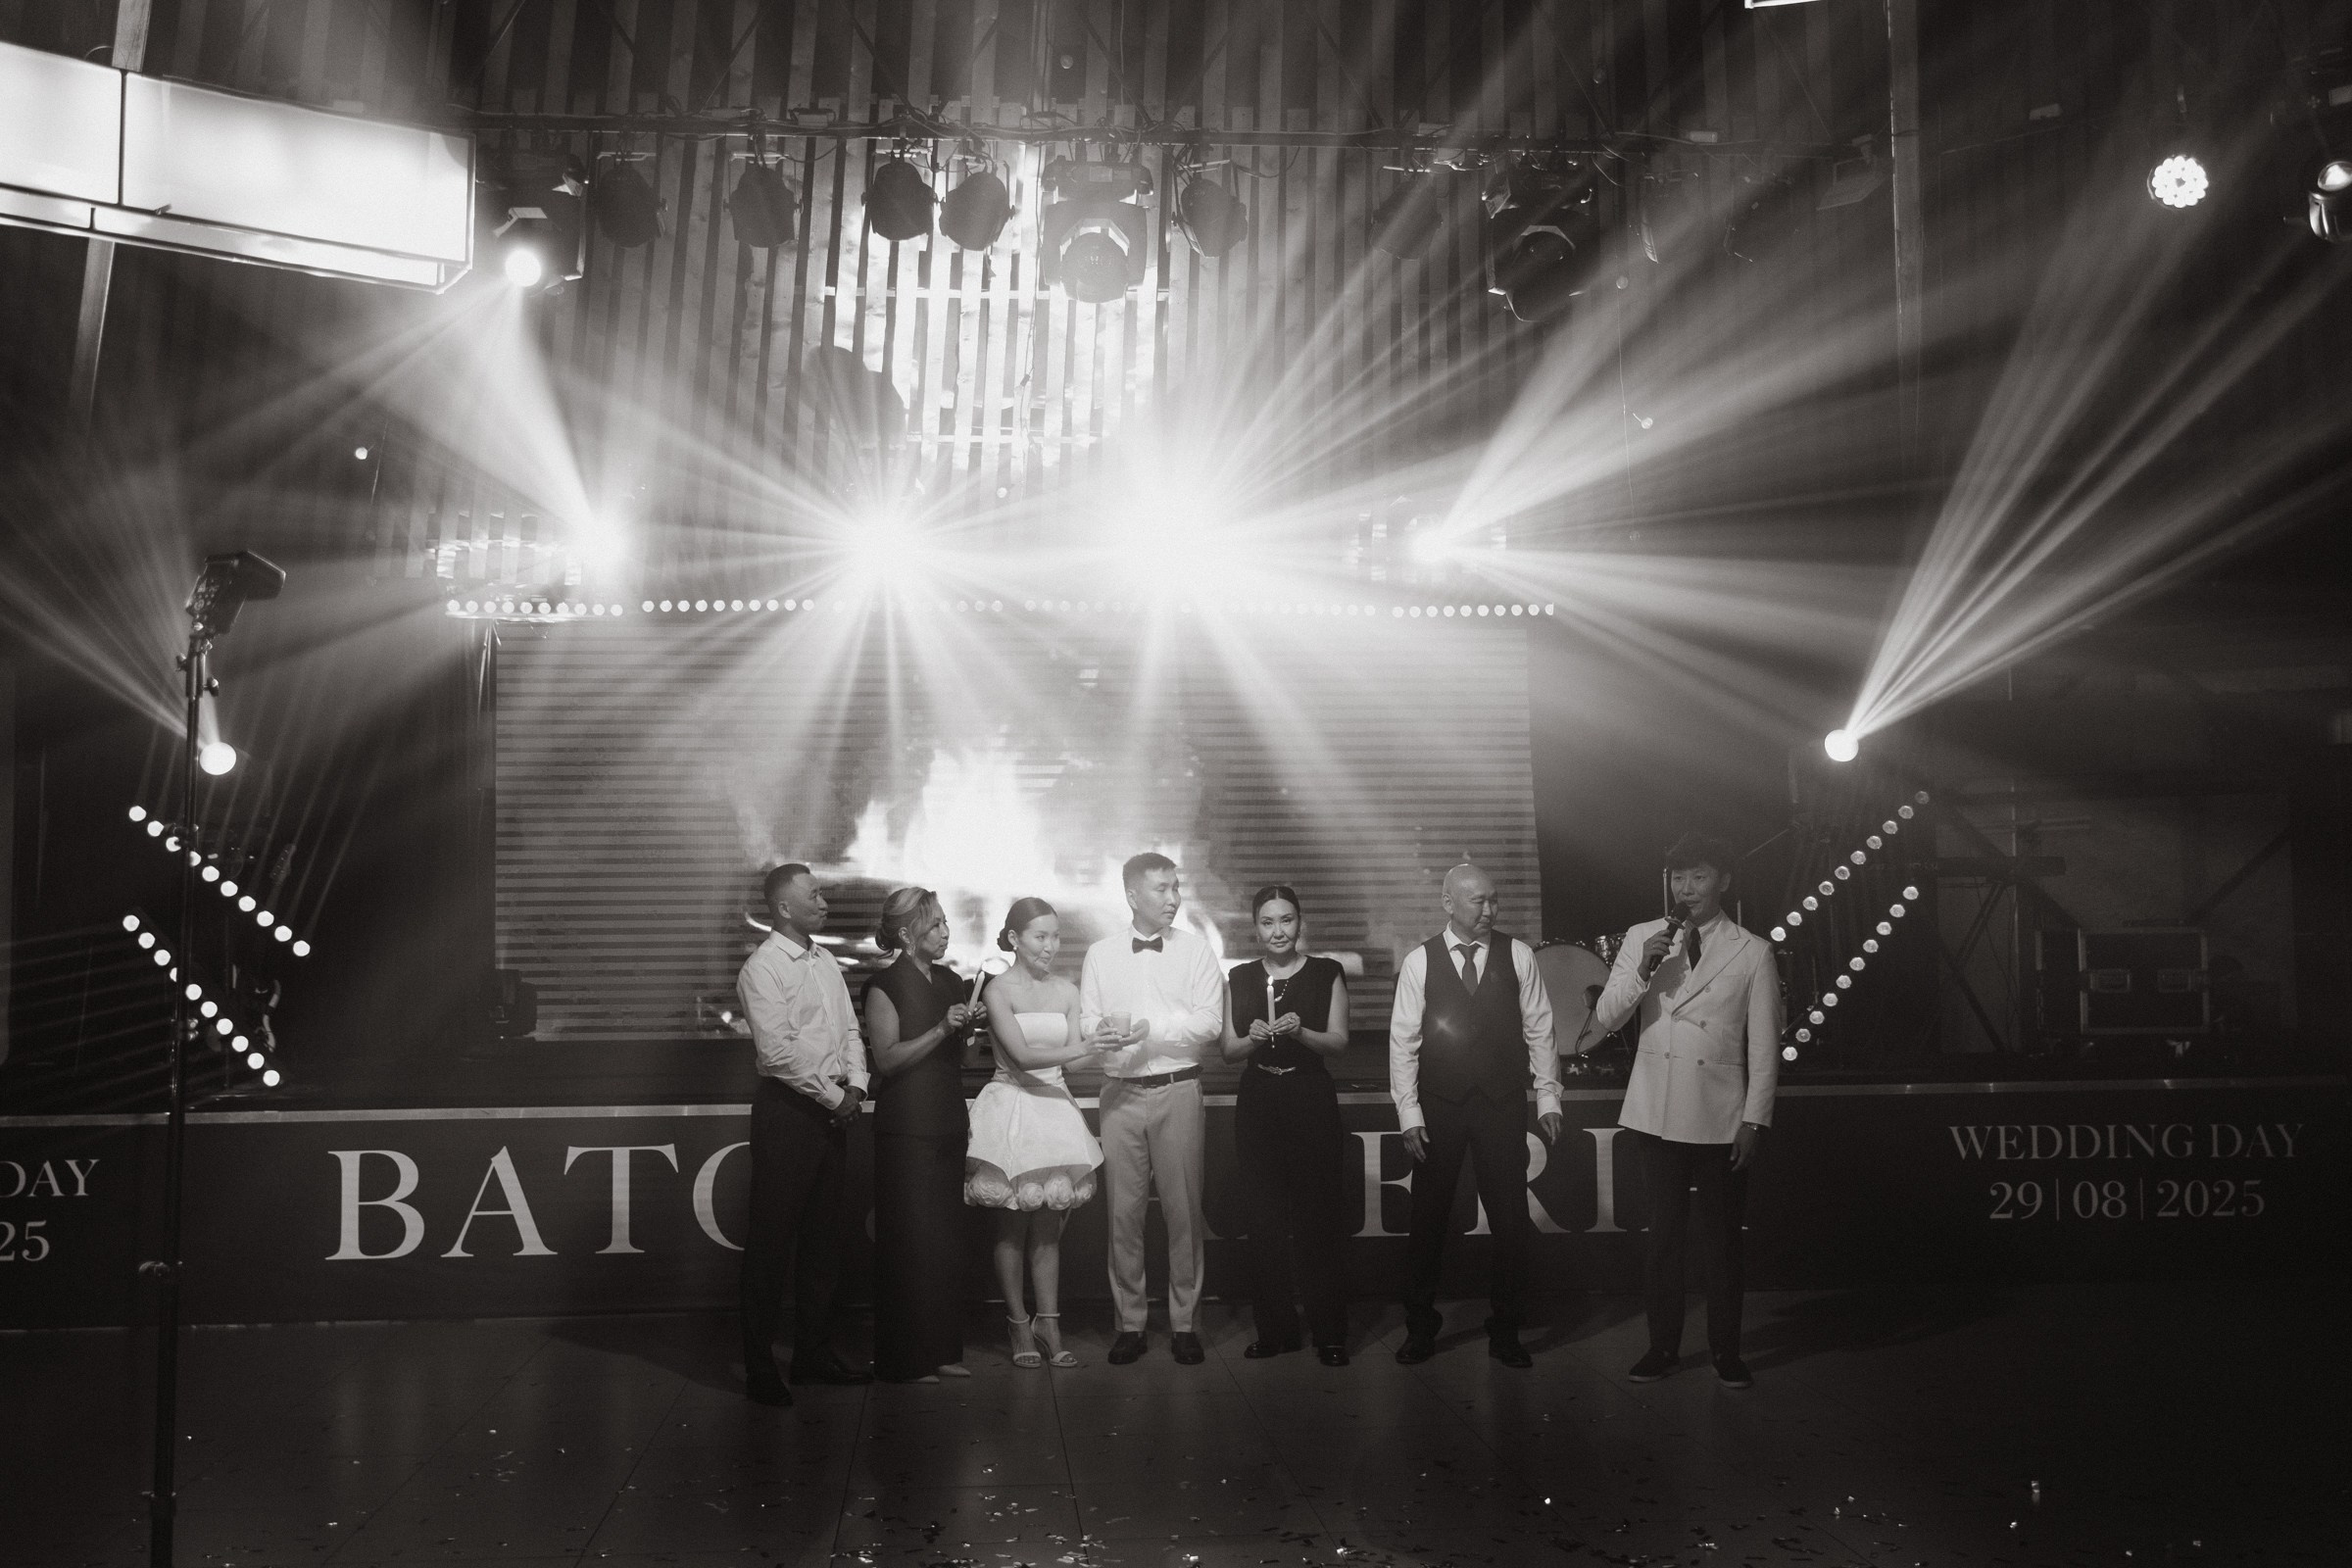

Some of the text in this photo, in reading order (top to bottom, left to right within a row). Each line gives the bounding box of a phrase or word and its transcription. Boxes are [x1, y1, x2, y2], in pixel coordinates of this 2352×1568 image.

[1948, 1123, 2303, 1159] WEDDING DAY
[0, 1159, 100, 1198] DAY
